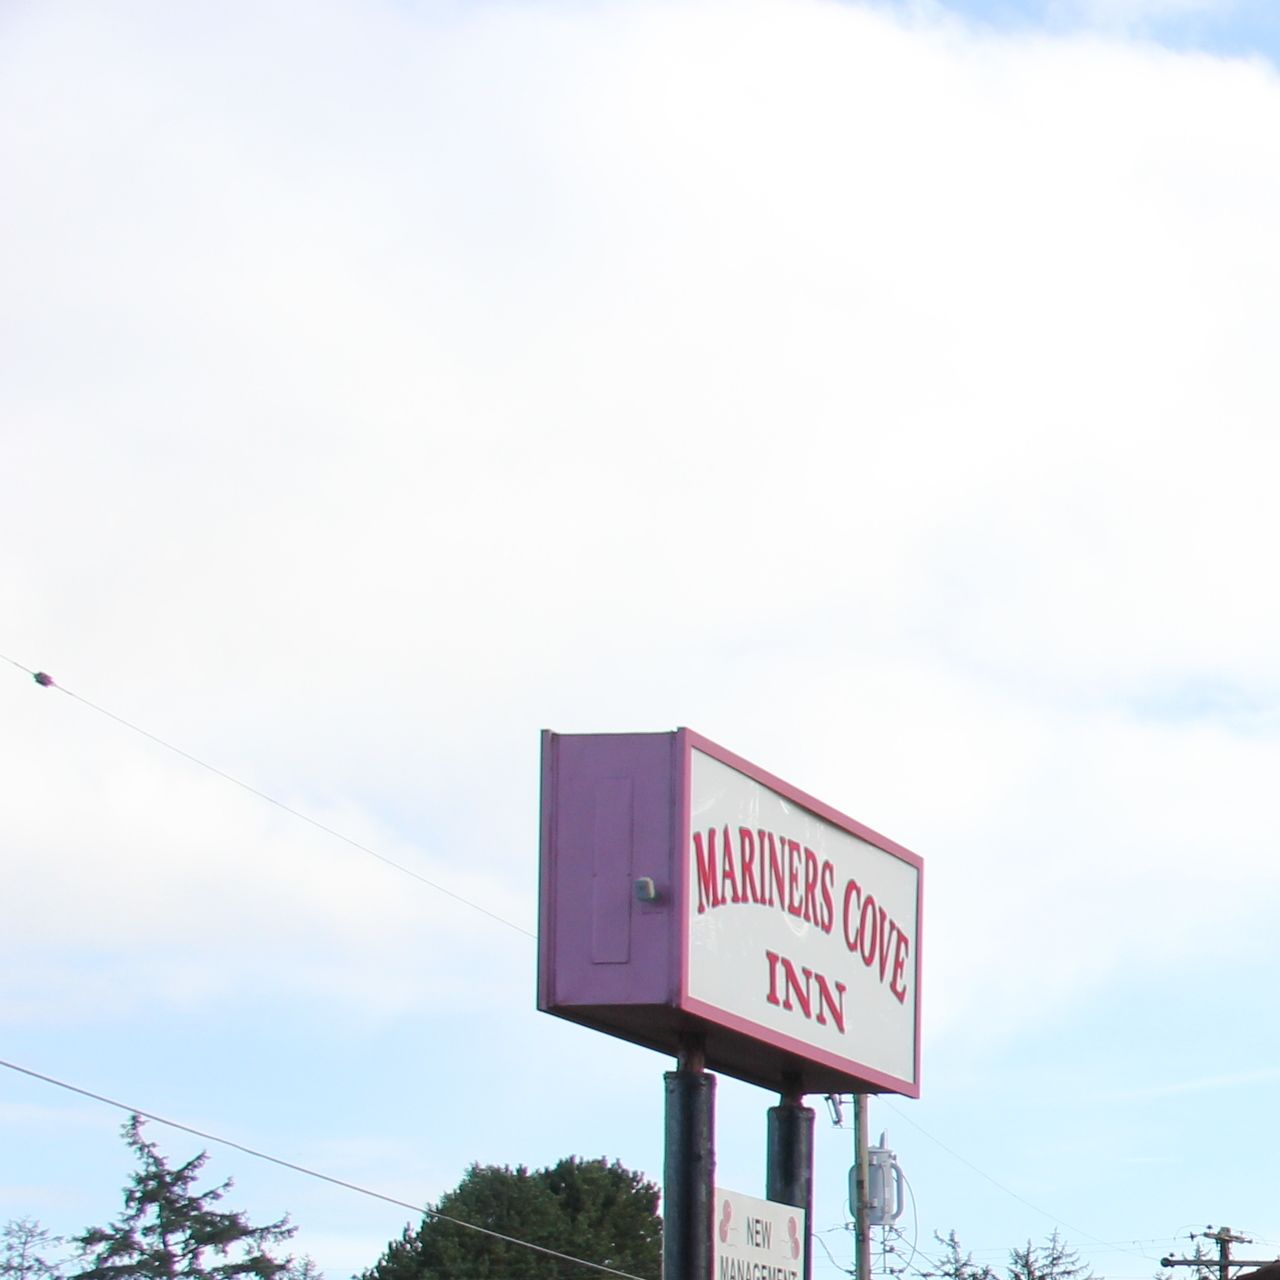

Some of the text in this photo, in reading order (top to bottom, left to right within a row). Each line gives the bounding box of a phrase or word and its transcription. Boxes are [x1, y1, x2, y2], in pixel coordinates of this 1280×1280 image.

[693, 824, 909, 1005] MARINERS COVE
[765, 949, 847, 1035] INN
[747, 1216, 772, 1250] NEW
